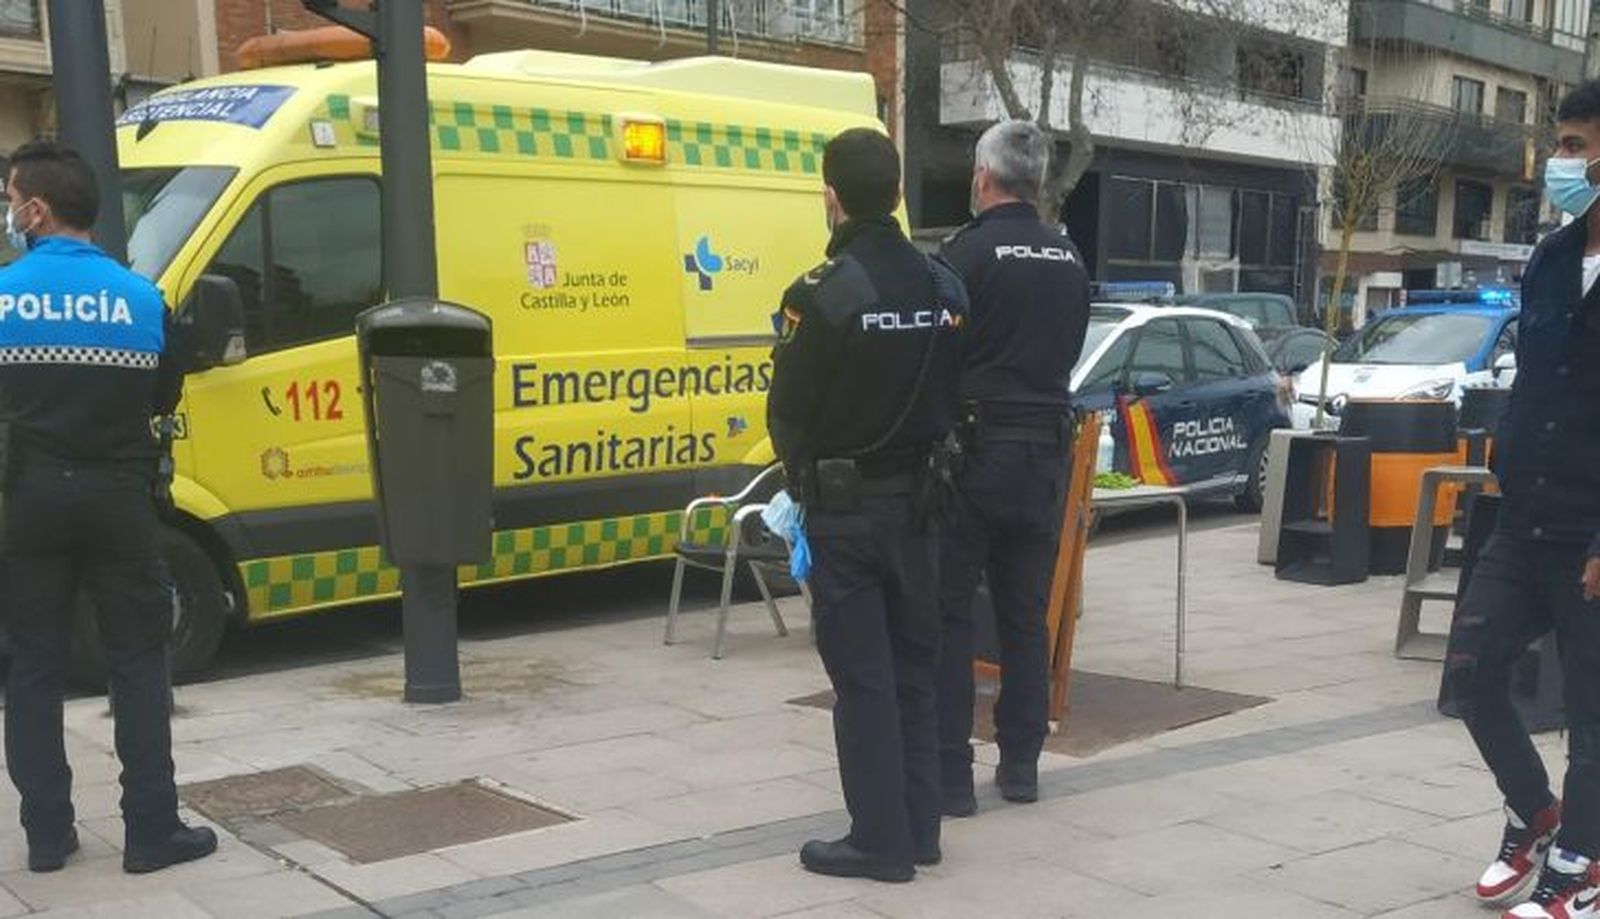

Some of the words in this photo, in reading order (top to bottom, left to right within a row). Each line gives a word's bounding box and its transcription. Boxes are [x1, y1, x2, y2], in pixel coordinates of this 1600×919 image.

[995, 245, 1077, 262] POLICIA
[563, 273, 605, 287] Junta
[609, 273, 628, 287] de
[0, 290, 133, 325] POLICÍA
[520, 293, 577, 309] Castilla
[580, 295, 588, 311] y
[593, 292, 630, 308] León
[862, 309, 953, 331] POLCA
[512, 355, 773, 413] Emergencias
[286, 380, 343, 422] 112
[1172, 416, 1234, 439] POLICIA
[513, 425, 716, 480] Sanitarias
[1168, 435, 1248, 458] NACIONAL
